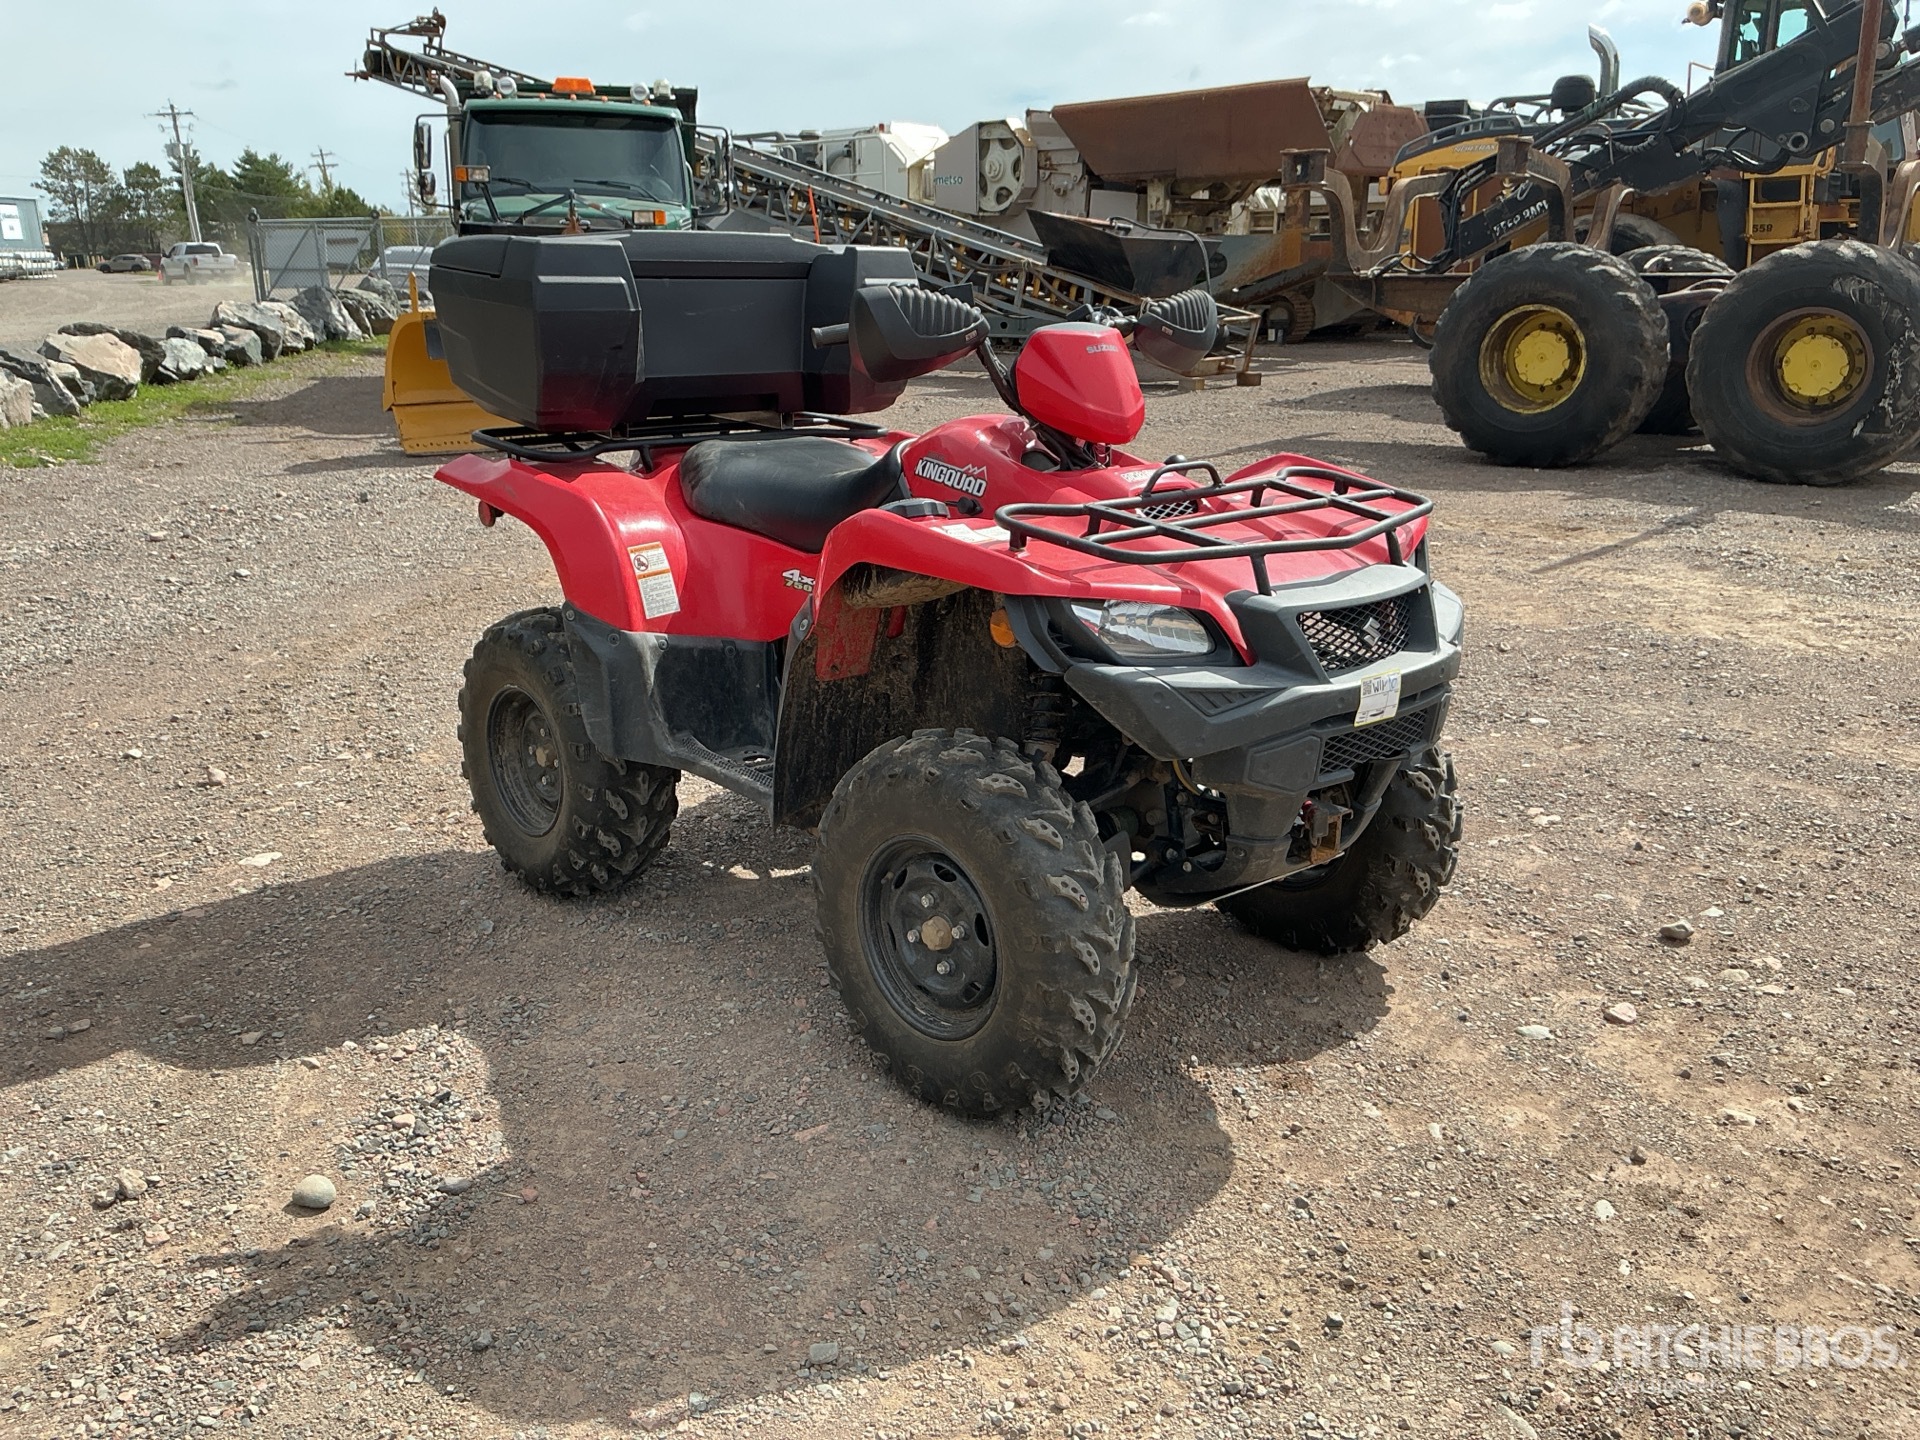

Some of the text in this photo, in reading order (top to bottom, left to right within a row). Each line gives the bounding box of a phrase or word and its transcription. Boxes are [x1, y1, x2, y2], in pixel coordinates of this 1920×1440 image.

[935, 175, 964, 185] metso
[914, 459, 987, 498] KINGQUAD
[785, 579, 813, 592] 750
